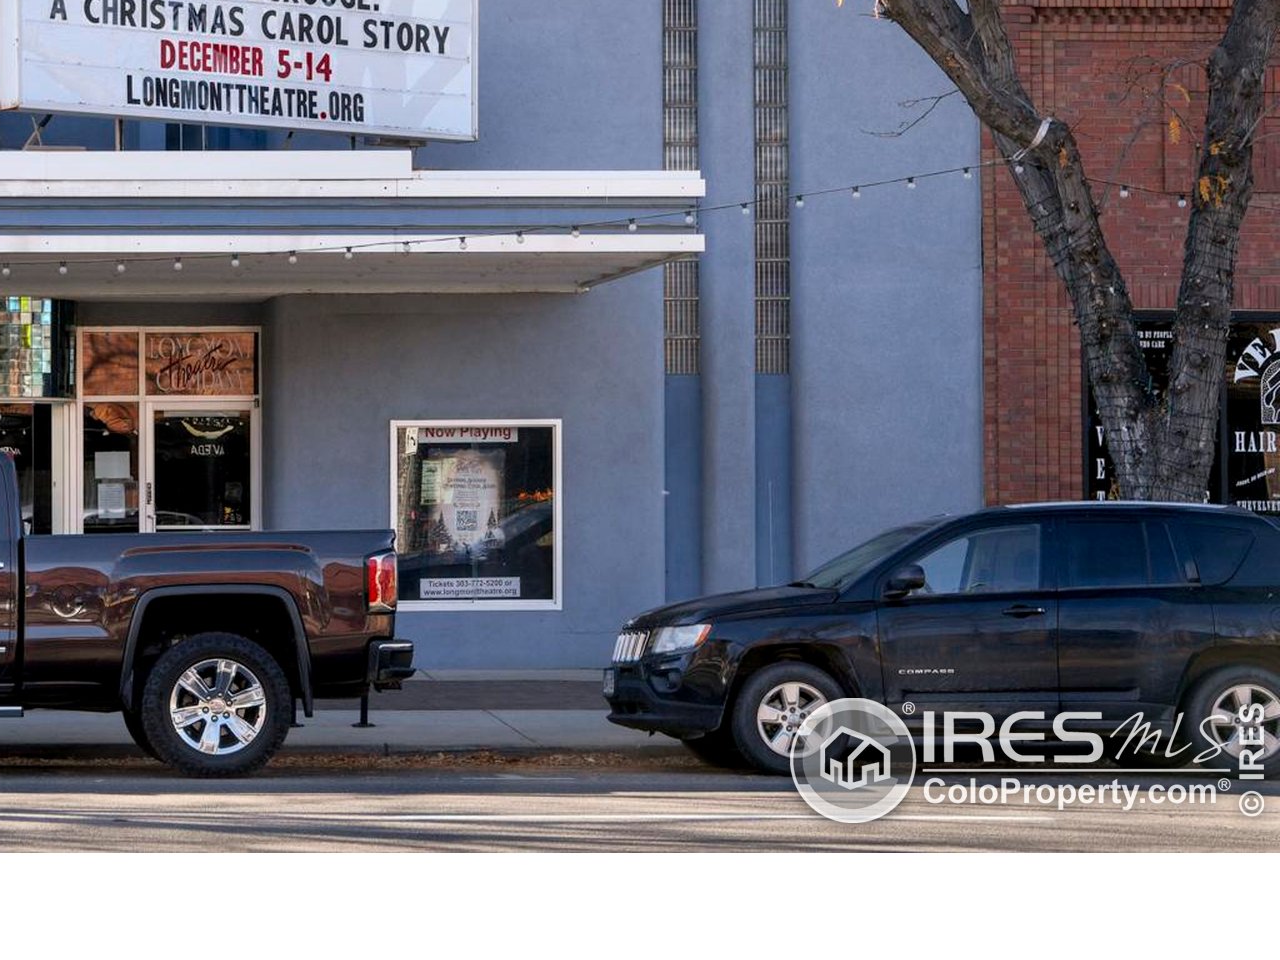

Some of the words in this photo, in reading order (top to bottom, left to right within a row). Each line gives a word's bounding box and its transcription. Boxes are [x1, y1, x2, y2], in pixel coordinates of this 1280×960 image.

[261, 10, 348, 46] CAROL
[363, 20, 450, 54] STORY
[160, 39, 263, 77] DECEMBER
[277, 49, 332, 82] 5-14
[126, 75, 365, 122] LONGMONTTHEATRE.ORG
[425, 427, 456, 438] Now
[460, 427, 511, 440] Playing
[1234, 431, 1277, 453] HAIR
